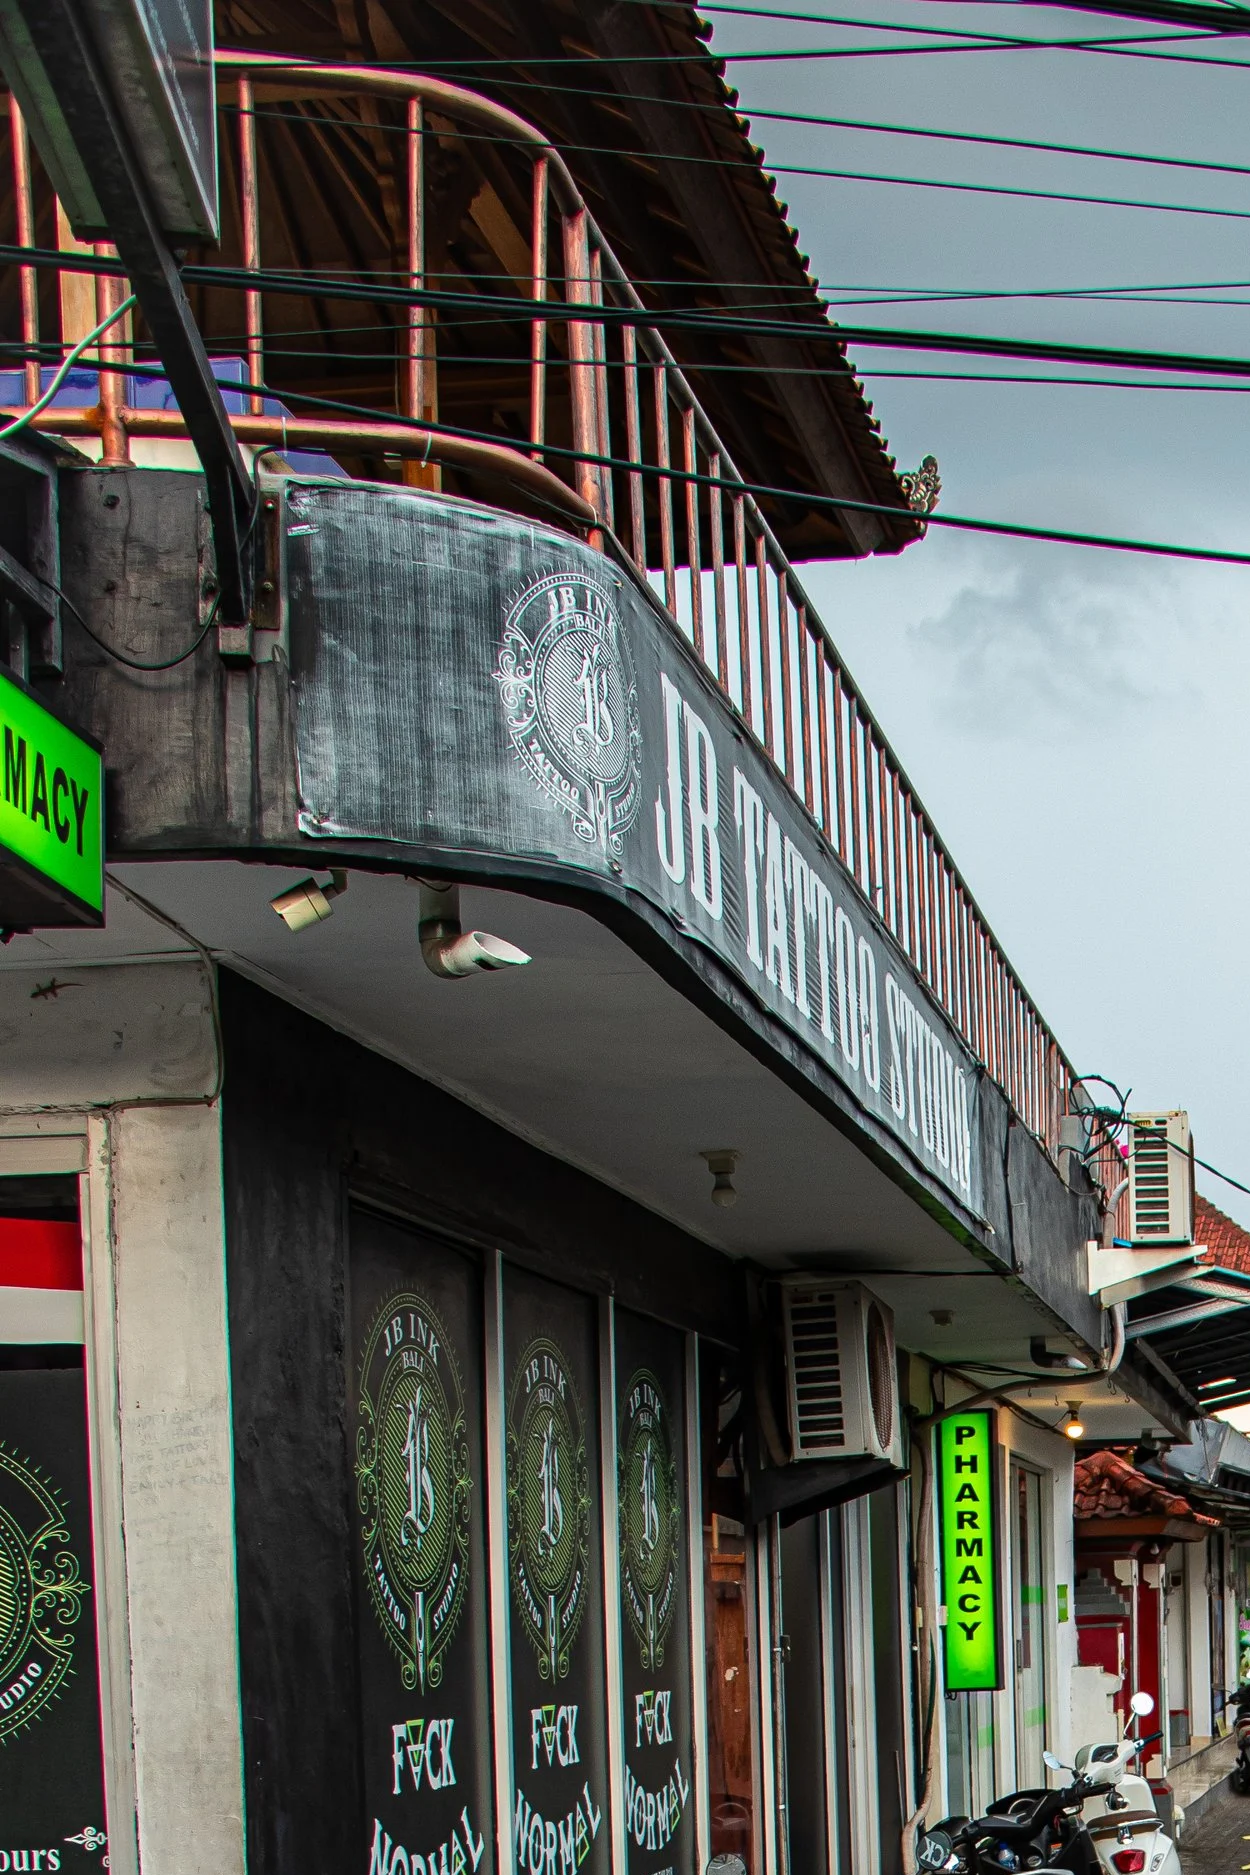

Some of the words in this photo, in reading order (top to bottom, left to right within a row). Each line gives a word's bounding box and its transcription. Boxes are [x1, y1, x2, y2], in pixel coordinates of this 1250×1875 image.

[548, 587, 577, 614] JB
[530, 738, 580, 801] TATTOO
[655, 672, 723, 921] JB
[734, 766, 881, 1092] TATTOO
[885, 972, 971, 1192] STUDIO
[385, 1316, 403, 1356] JB
[410, 1313, 439, 1365] INK
[402, 1351, 424, 1372] BALI
[954, 1425, 983, 1641] PHARMACY
[376, 1553, 405, 1630] TATTOO
[433, 1561, 459, 1630] STUDIO
[624, 1757, 689, 1850] NORMAL
